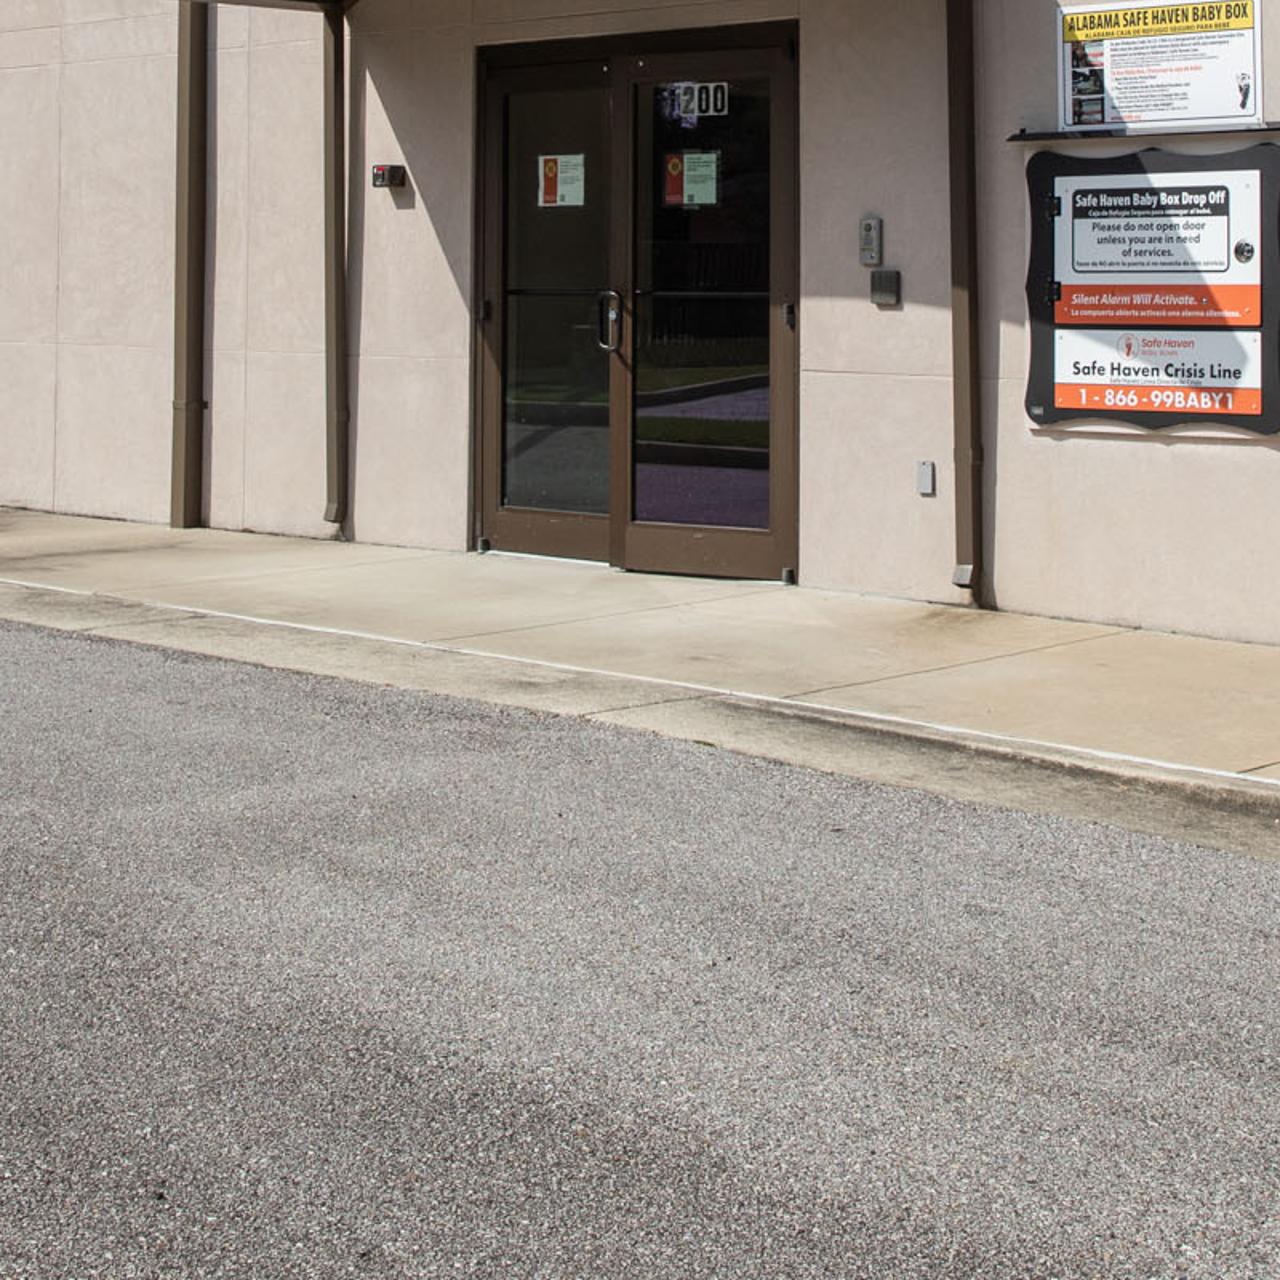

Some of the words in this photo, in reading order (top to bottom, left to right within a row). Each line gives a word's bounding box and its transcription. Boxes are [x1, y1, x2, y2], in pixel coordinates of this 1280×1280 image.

[1068, 13, 1120, 31] ALABAMA
[1122, 10, 1148, 27] SAFE
[1151, 7, 1189, 24] HAVEN
[1192, 4, 1222, 21] BABY
[1225, 2, 1248, 19] BOX
[1075, 194, 1098, 207] Safe
[1099, 193, 1130, 207] Haven
[1132, 191, 1158, 209] Baby
[1159, 192, 1180, 205] Box
[1182, 191, 1206, 207] Drop
[1208, 189, 1226, 204] Off
[1092, 222, 1121, 232] Please
[1123, 222, 1136, 231] do
[1138, 222, 1153, 231] not
[1156, 223, 1179, 234] open
[1182, 221, 1205, 231] door
[1097, 234, 1126, 245] unless
[1128, 236, 1146, 247] you
[1148, 236, 1162, 244] are
[1165, 234, 1174, 243] in
[1176, 233, 1200, 243] need
[1122, 247, 1132, 257] of
[1134, 248, 1174, 257] services.
[1072, 293, 1100, 305] Silent
[1101, 294, 1131, 305] Alarm
[1132, 293, 1152, 305] Will
[1153, 294, 1198, 305] Activate.
[1141, 337, 1162, 348] Safe
[1163, 338, 1194, 349] Haven
[1073, 361, 1105, 376] Safe
[1110, 362, 1159, 377] Haven
[1164, 363, 1205, 378] Crisis
[1210, 364, 1242, 380] Line
[1079, 389, 1086, 405] 1
[1104, 389, 1138, 406] 866
[1150, 391, 1233, 410] 99BABY1
